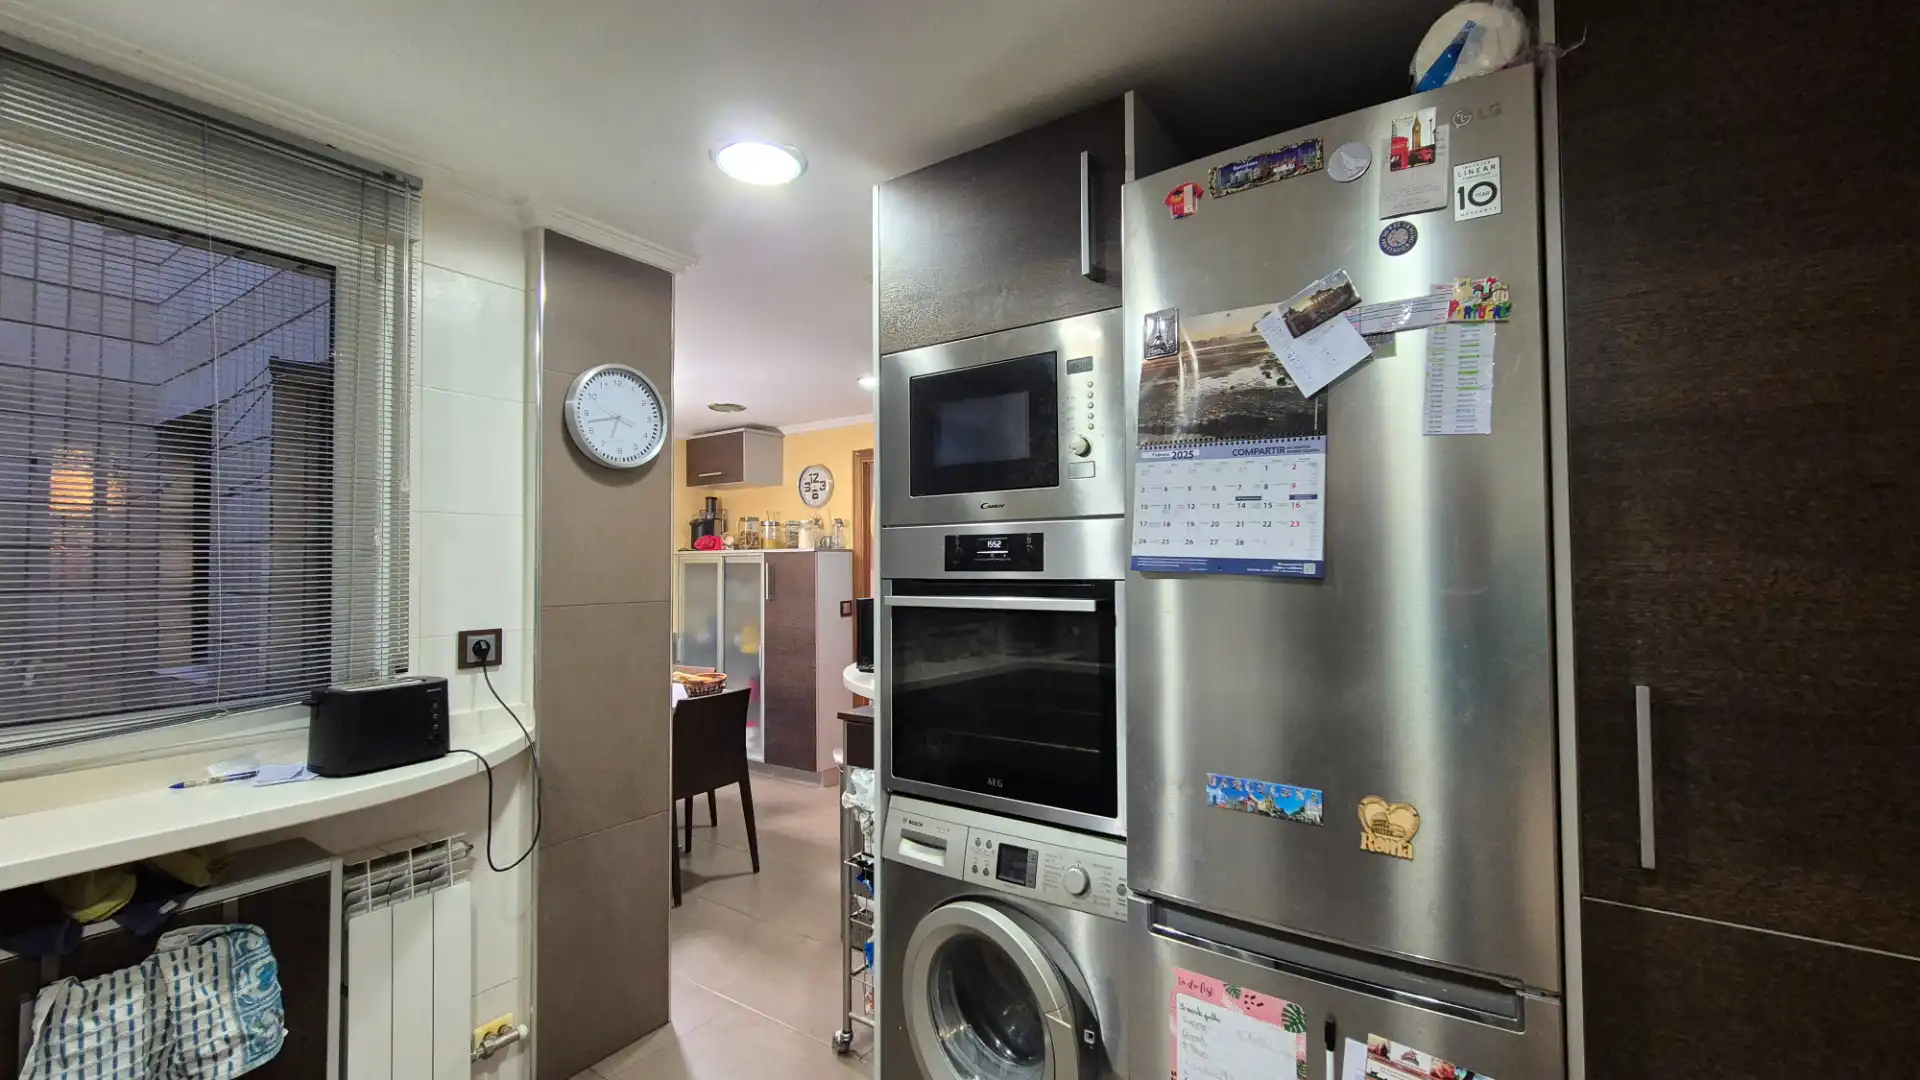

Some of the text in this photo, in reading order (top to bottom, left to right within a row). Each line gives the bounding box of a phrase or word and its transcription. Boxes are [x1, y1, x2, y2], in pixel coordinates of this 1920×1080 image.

[1477, 101, 1502, 120] LG
[1457, 164, 1496, 177] LINEAR
[1457, 181, 1498, 210] 10
[1474, 190, 1491, 198] YEAR
[1171, 450, 1194, 460] 2025
[1232, 446, 1286, 457] COMPARTIR
[987, 540, 1002, 548] 1552
[987, 777, 1003, 788] AEG
[908, 819, 923, 827] BOSCH
[1360, 832, 1414, 861] Roma
